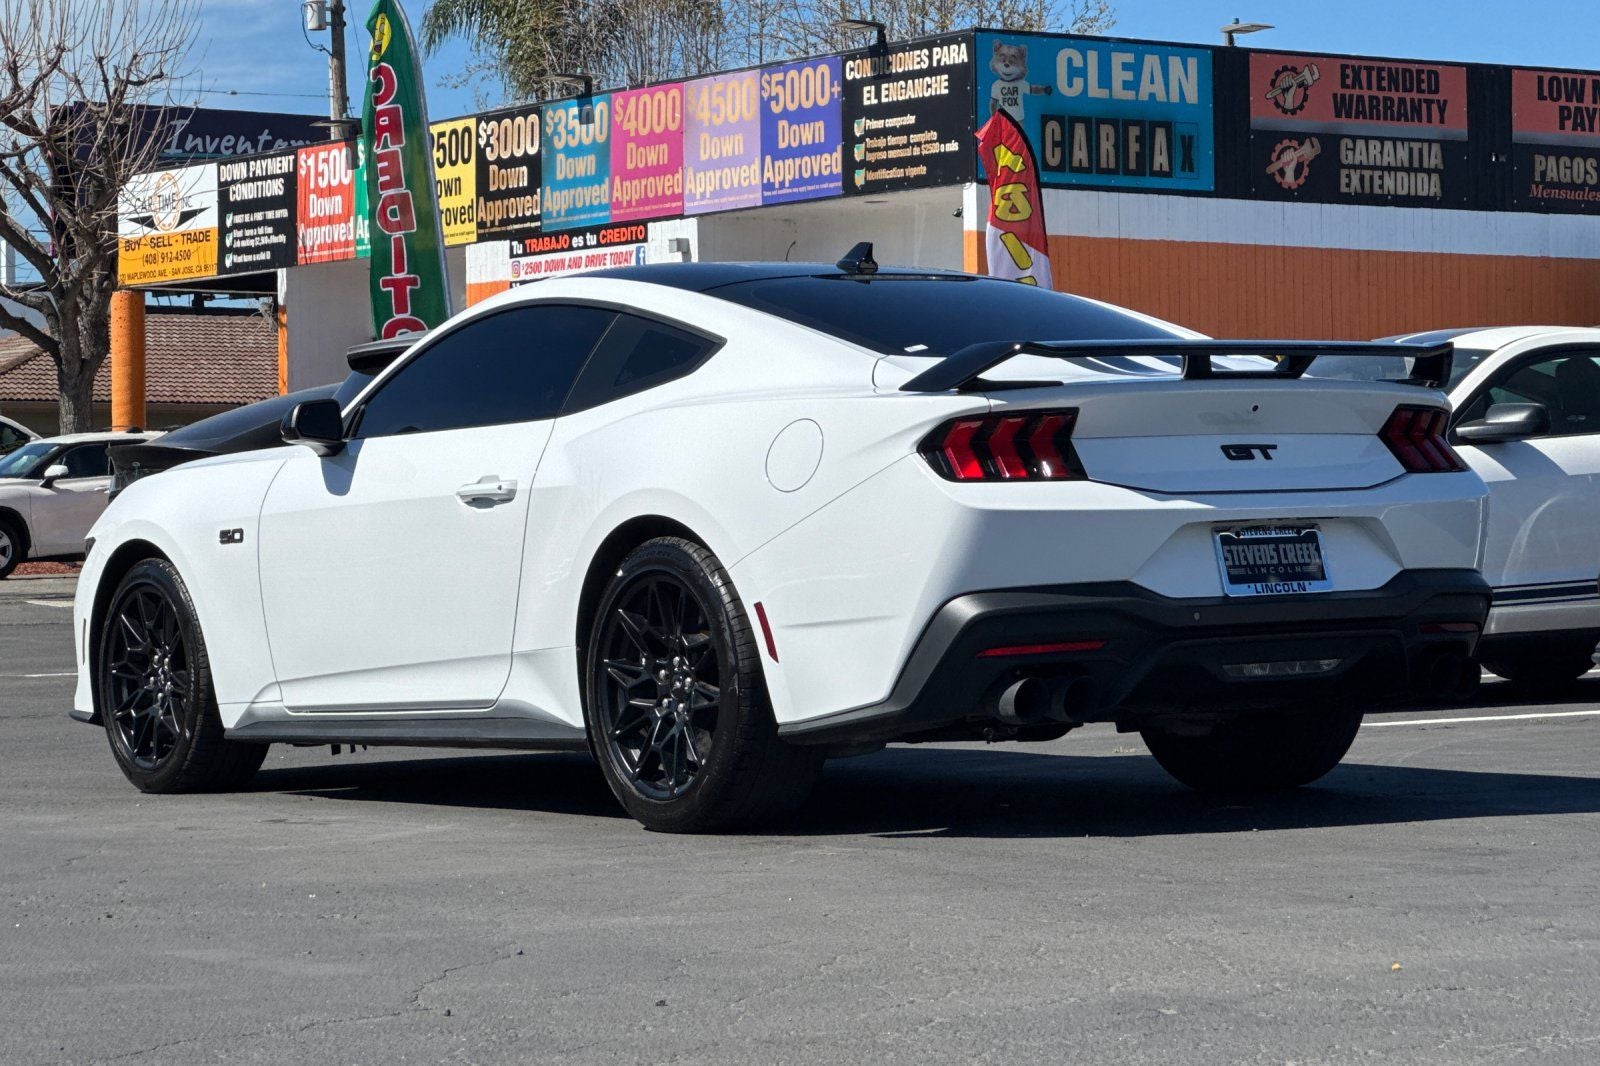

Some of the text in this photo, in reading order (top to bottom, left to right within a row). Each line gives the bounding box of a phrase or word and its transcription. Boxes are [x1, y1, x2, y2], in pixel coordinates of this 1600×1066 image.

[846, 42, 968, 80] CONDICIONES PARA
[761, 63, 841, 115] $5000+
[863, 74, 949, 106] EL ENGANCHE
[1001, 85, 1019, 96] CAR
[1056, 48, 1199, 105] CLEAN
[1340, 63, 1440, 95] EXTENDED
[1537, 75, 1586, 103] LOW
[615, 87, 681, 138] $4000
[687, 76, 756, 128] $4500
[1002, 97, 1019, 107] FOX
[1332, 93, 1448, 125] WARRANTY
[545, 101, 609, 150] $3500
[778, 119, 825, 149] Down
[1559, 105, 1600, 133] PAY
[478, 113, 540, 162] $3000
[700, 131, 744, 161] Down
[1044, 120, 1195, 173] CARFAX
[220, 154, 295, 182] DOWN PAYMENT
[300, 146, 353, 190] $1500
[556, 153, 596, 181] Down
[626, 141, 668, 170] Down
[763, 143, 842, 188] Approved
[1339, 137, 1444, 170] GARANTIA
[489, 164, 528, 192] Down
[685, 157, 760, 200] Approved
[1340, 168, 1442, 197] EXTENDIDA
[1534, 154, 1598, 185] PAGOS
[229, 178, 285, 202] CONDITIONS
[437, 175, 462, 199] own
[543, 177, 609, 217] Approved
[612, 166, 683, 207] Approved
[1530, 184, 1600, 201] Mensuales
[309, 193, 343, 218] Down
[477, 188, 541, 227] Approved
[124, 229, 211, 252] BUY SELL TRADE
[298, 216, 354, 252] Approved
[512, 225, 645, 255] Tu TRABAJO es tu CREDITO
[142, 252, 159, 267] (408)
[522, 249, 634, 276] $2500 DOWN AND DRIVE TODAY
[1220, 444, 1278, 461] GT
[1223, 542, 1319, 566] STEVENS CREEK
[1247, 565, 1302, 575] LINCOLN
[1254, 582, 1307, 594] LINCOLN
